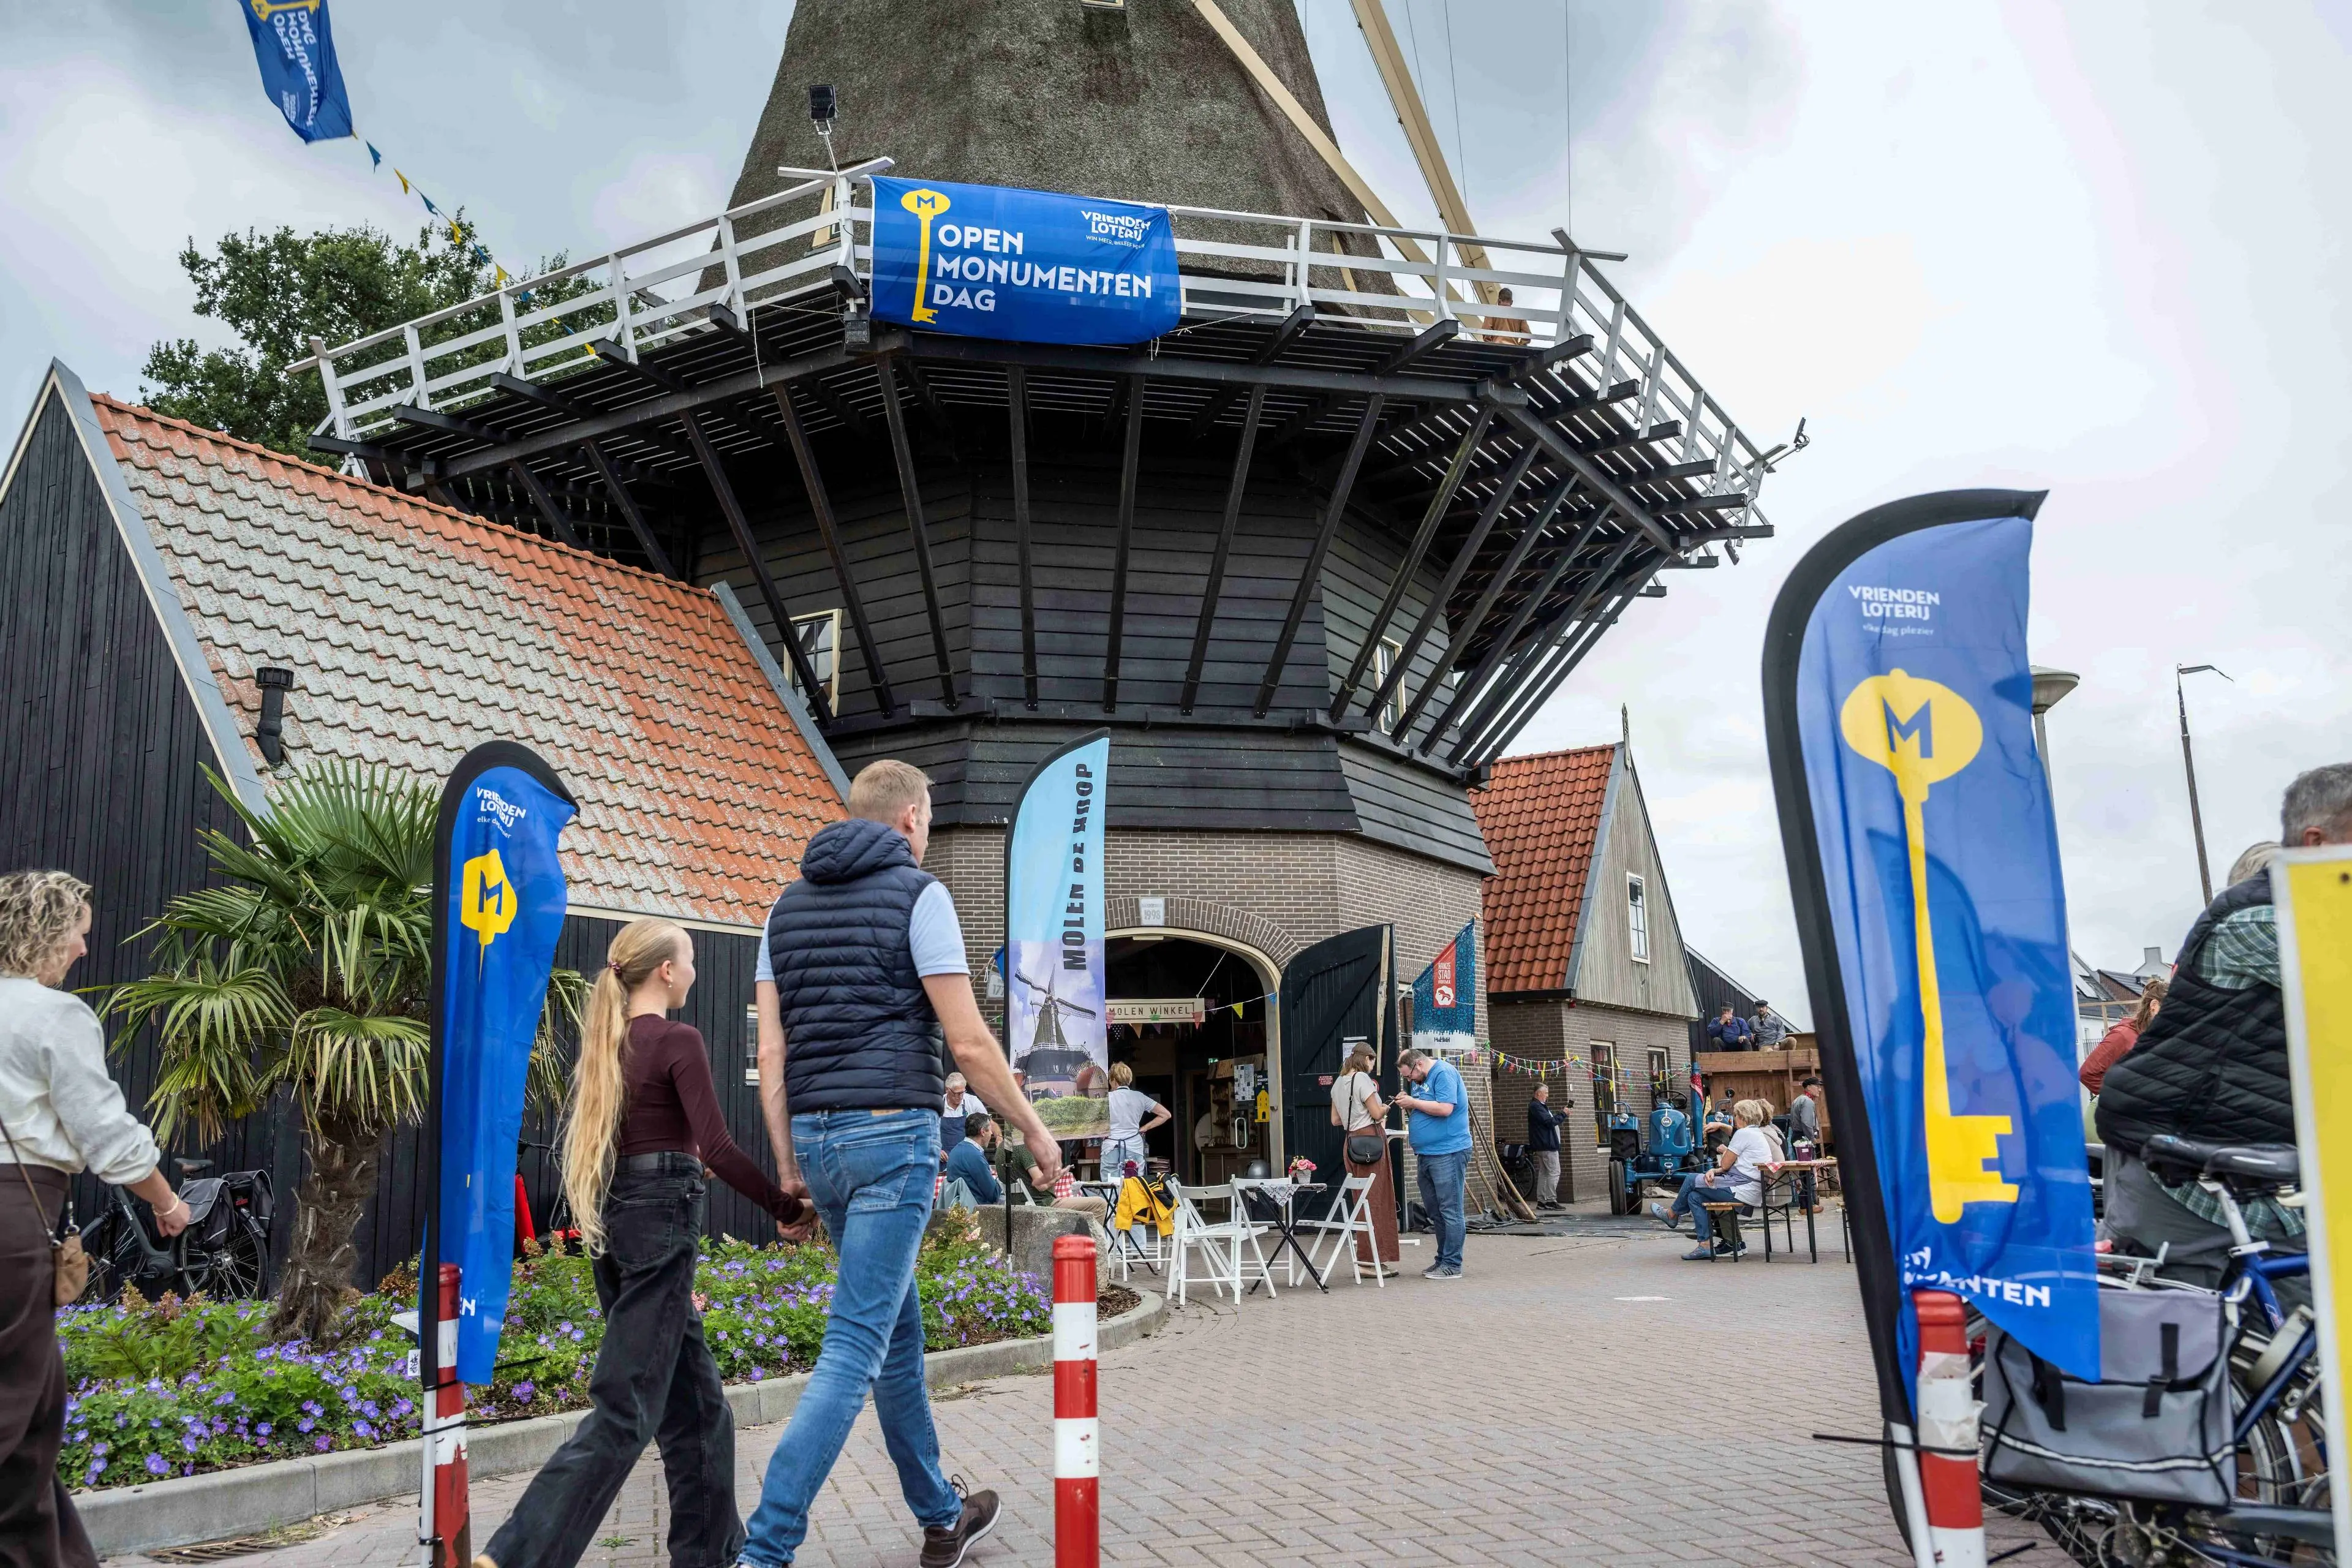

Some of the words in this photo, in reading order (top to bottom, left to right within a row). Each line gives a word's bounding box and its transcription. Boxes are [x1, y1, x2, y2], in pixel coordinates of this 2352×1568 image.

[917, 195, 935, 209] M
[1080, 211, 1151, 230] VRIENDEN
[938, 225, 1023, 255] OPEN
[1091, 221, 1142, 241] LOTERIJ
[937, 253, 1152, 298] MONUMENTEN
[933, 284, 996, 312] DAG
[1848, 585, 1940, 605] VRIENDEN
[1862, 601, 1930, 621] LOTERIJ
[1901, 625, 1934, 636] plezier
[1882, 696, 1932, 758] M
[477, 786, 527, 819] VRIENDEN
[1072, 763, 1093, 834] HOOP
[1061, 883, 1087, 970] MOLEN
[1438, 970, 1450, 979] STAD
[1109, 1007, 1144, 1016] MOLEN
